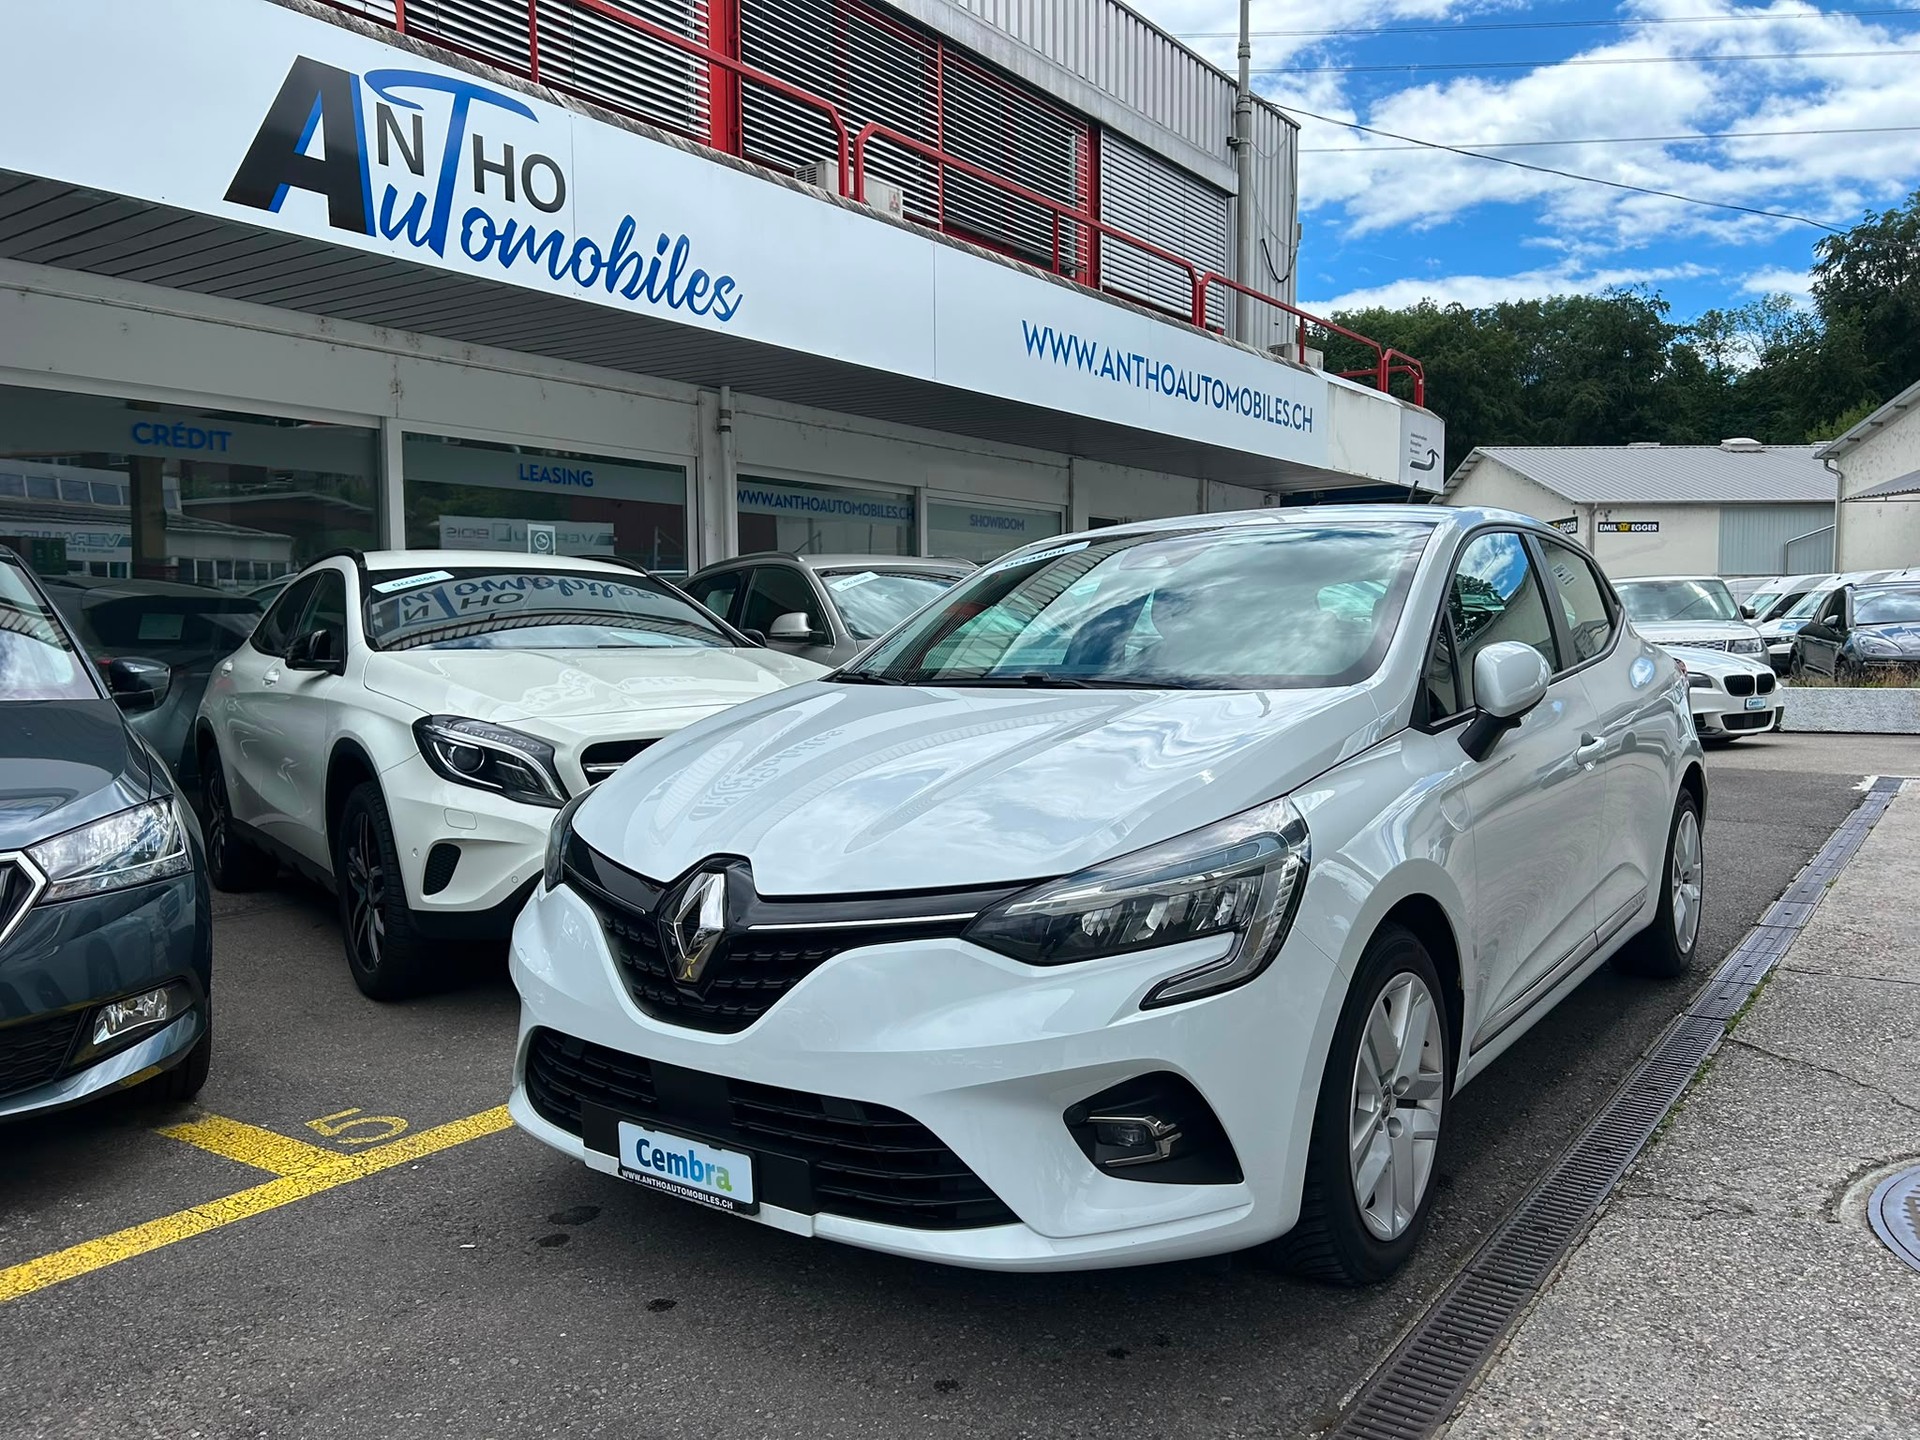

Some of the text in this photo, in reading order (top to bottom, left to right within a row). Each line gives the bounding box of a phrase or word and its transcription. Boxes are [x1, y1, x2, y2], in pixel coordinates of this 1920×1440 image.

[1021, 319, 1313, 433] WWW.ANTHOAUTOMOBILES.CH
[132, 421, 232, 451] CRÉDIT
[519, 463, 594, 487] LEASING
[970, 514, 1024, 531] SHOWROOM
[392, 575, 437, 587] Occasion
[304, 1107, 409, 1144] 5
[636, 1138, 732, 1192] Cembra
[622, 1168, 734, 1210] WWW.ANTHOAUTOMOBILES.CH
